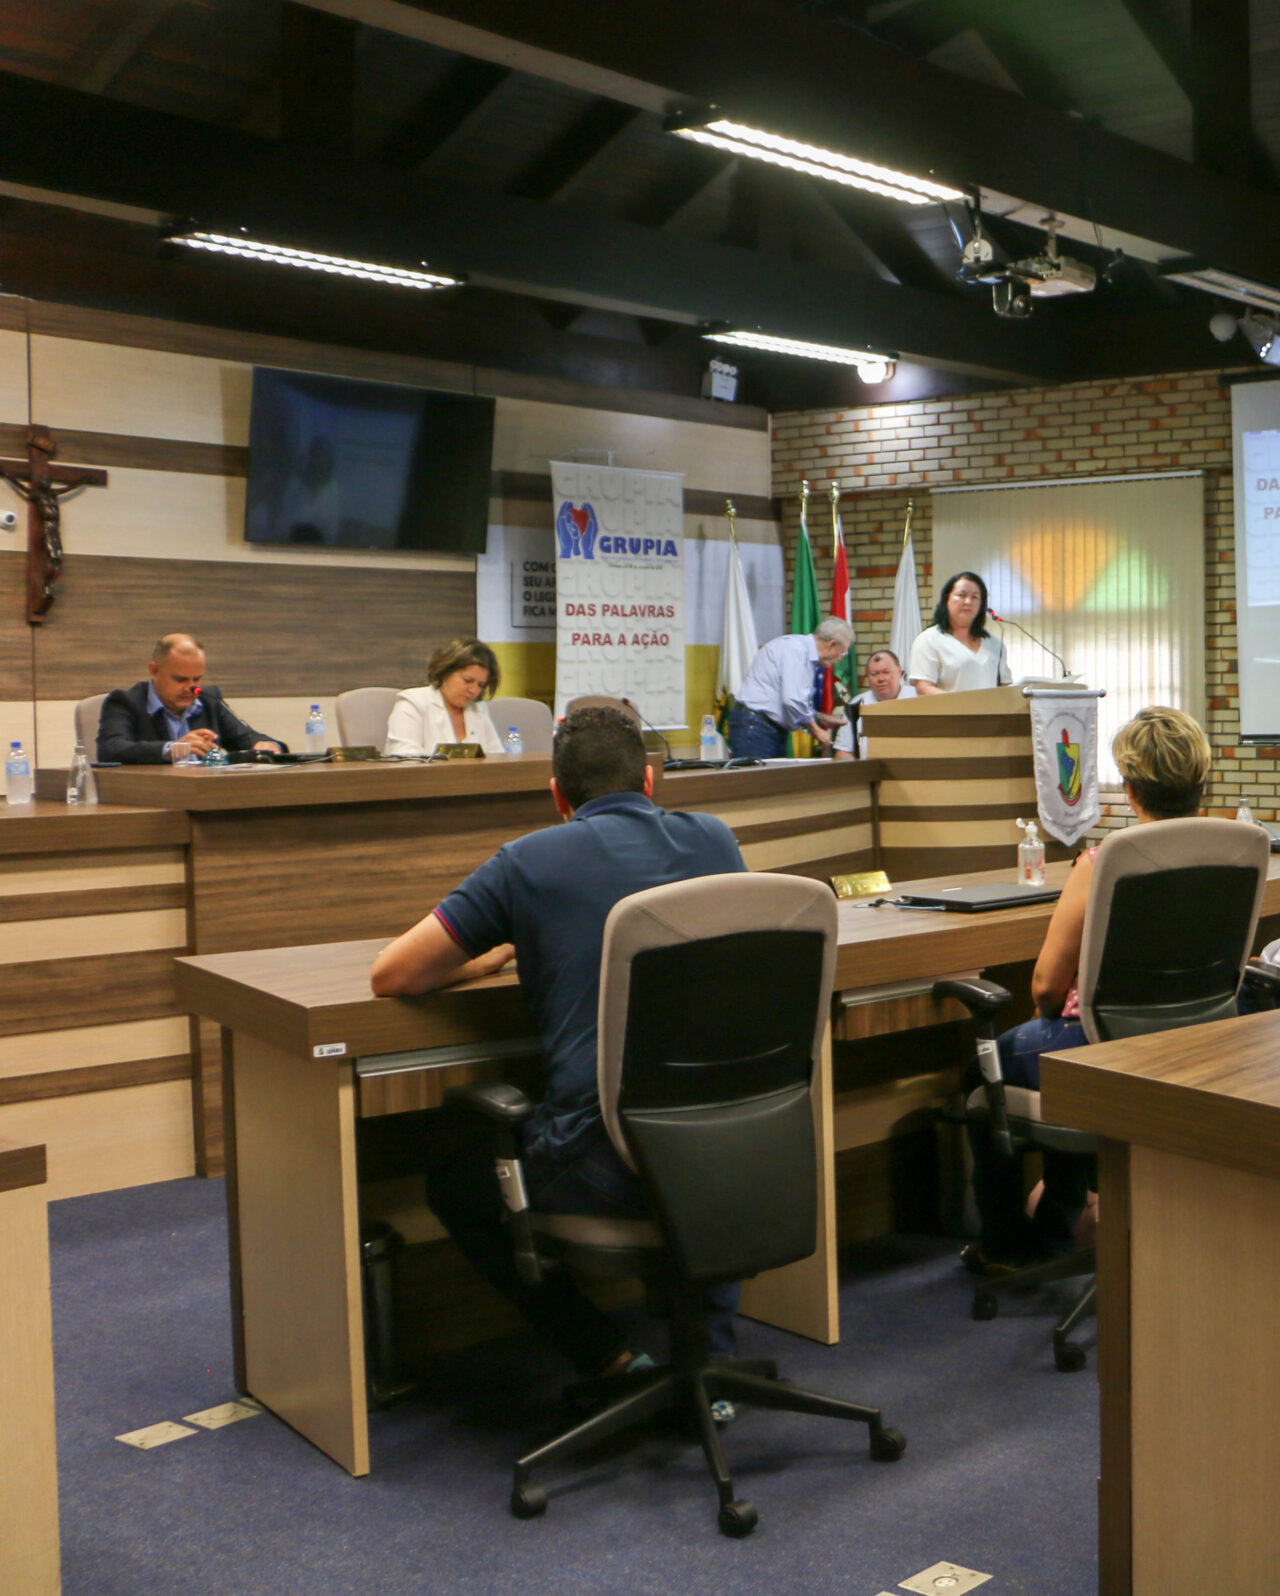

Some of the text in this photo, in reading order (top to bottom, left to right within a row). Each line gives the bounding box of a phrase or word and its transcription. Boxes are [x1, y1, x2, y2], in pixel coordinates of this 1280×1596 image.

[599, 536, 678, 557] GRUPIA
[522, 561, 549, 572] COM
[523, 575, 542, 587] SEU
[523, 591, 532, 601] O
[523, 605, 546, 617] FICA
[565, 603, 675, 618] DAS PALAVRAS
[571, 630, 670, 649] PARA A AÇÃO
